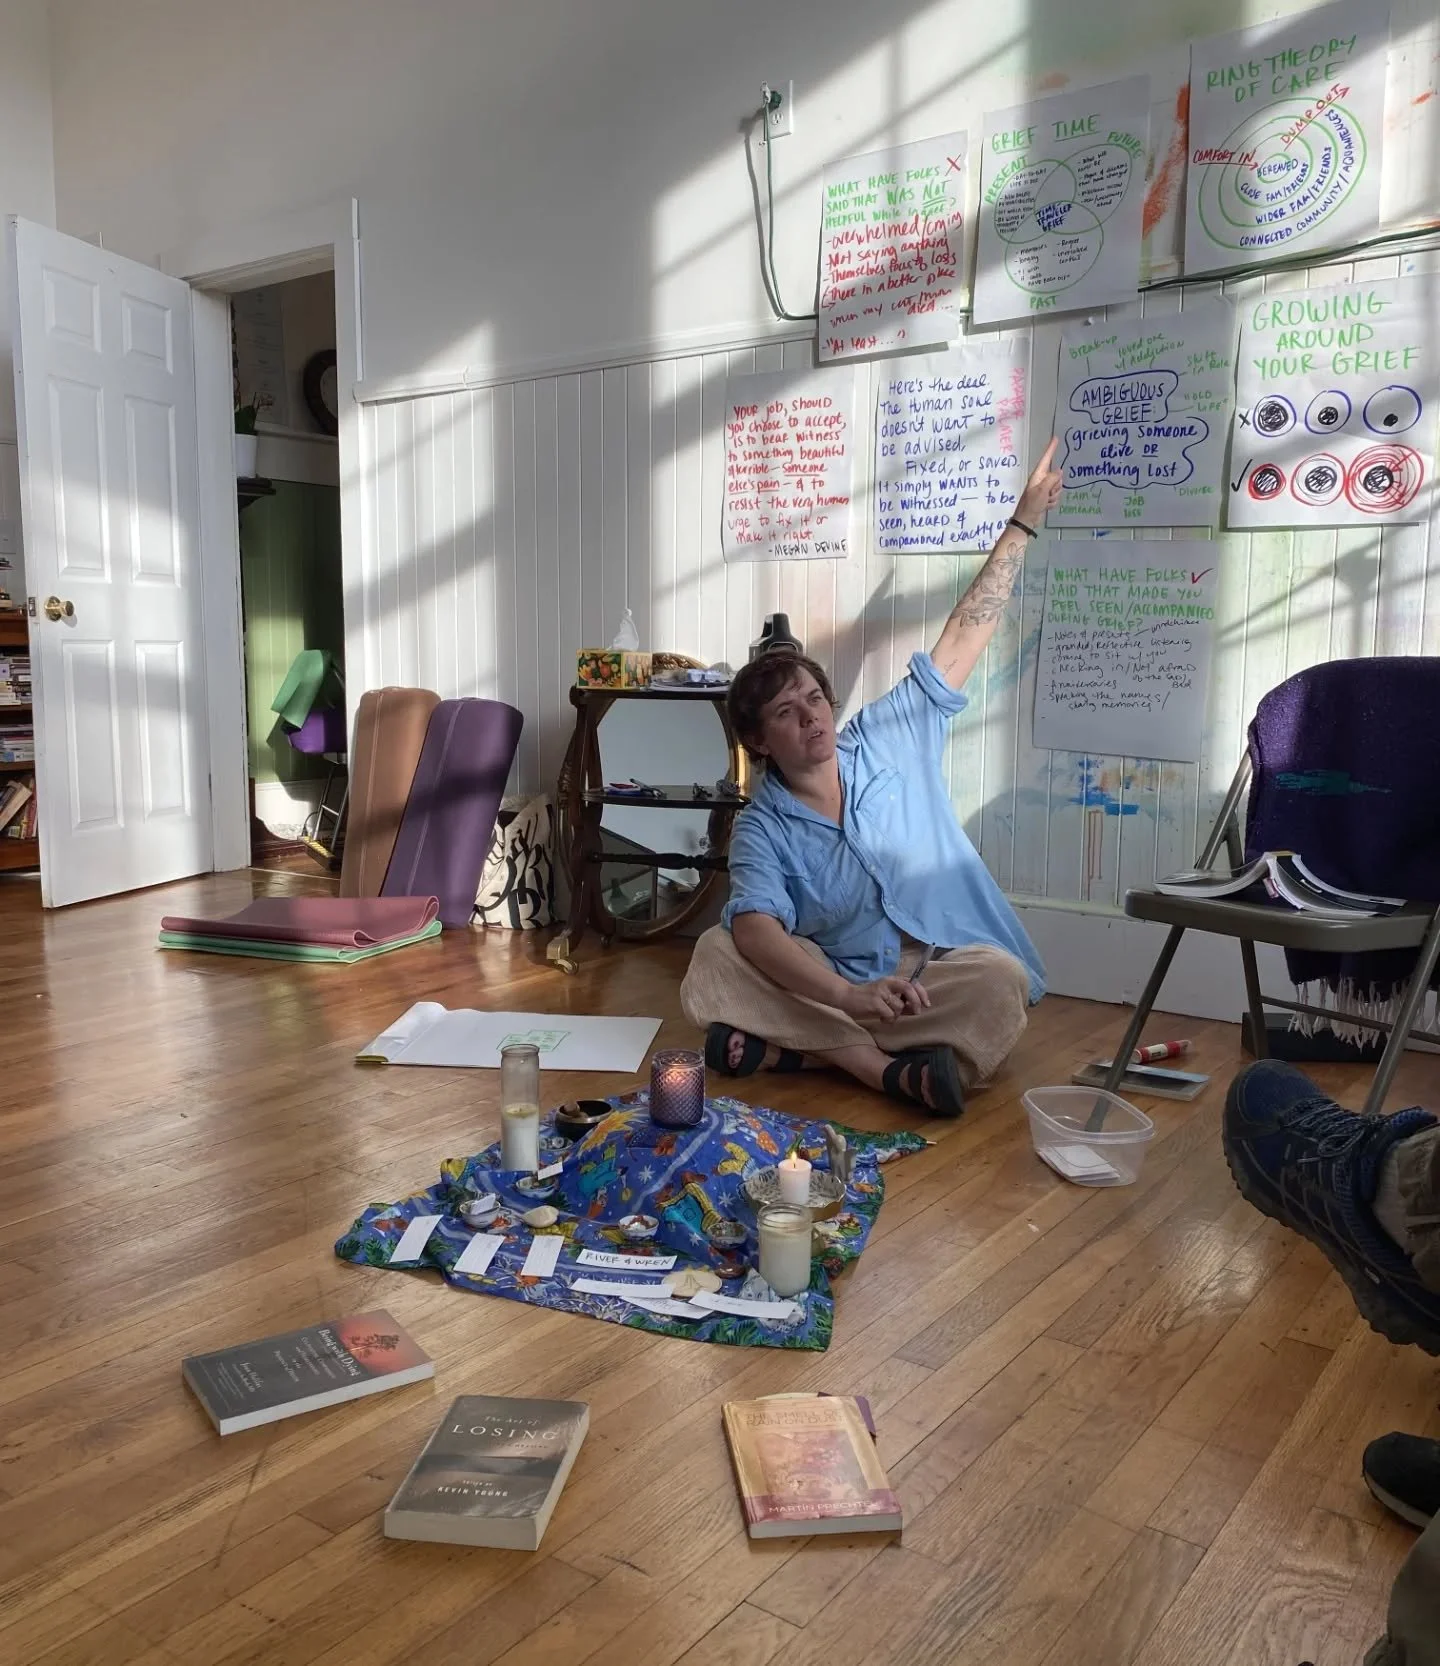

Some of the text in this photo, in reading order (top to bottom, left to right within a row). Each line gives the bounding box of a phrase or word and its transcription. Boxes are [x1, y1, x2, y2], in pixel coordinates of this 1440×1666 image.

[1207, 35, 1356, 92] RING THEORY
[1235, 61, 1345, 102] OF CARE
[1281, 84, 1341, 144] DUMP OUT
[991, 115, 1100, 151] GRIEF TIME
[1108, 131, 1146, 159] FUTURE
[1193, 149, 1256, 163] COMFORT IN
[1257, 159, 1298, 177] BEREAVED
[828, 167, 940, 200] WHAT HAVE FOLKS
[984, 156, 1029, 204] PRESENT
[1241, 183, 1260, 199] CLOSE
[826, 201, 849, 213] SAID
[853, 195, 877, 208] THAT
[887, 190, 914, 204] WAS
[826, 213, 864, 229] HELPFUL
[1256, 207, 1286, 224] WIDER
[1240, 228, 1292, 246] CONNECTED
[858, 246, 897, 262] saying
[1030, 296, 1057, 309] PAST
[1253, 291, 1392, 331] GROWING
[1277, 323, 1374, 352] AROUND
[1253, 346, 1422, 380] YOUR GRIEF
[889, 378, 923, 395] Here's
[929, 378, 953, 392] the
[1082, 382, 1164, 407] AMBIGUOUS
[880, 402, 901, 415] The
[961, 391, 993, 409] soul
[728, 421, 744, 439] you
[749, 420, 783, 433] choose
[788, 416, 798, 427] to
[882, 416, 924, 438] doesn't
[981, 413, 995, 429] to
[734, 436, 743, 448] is
[747, 435, 756, 444] to
[1073, 427, 1129, 451] grieving
[728, 444, 844, 463] to something beautiful
[882, 443, 895, 456] be
[1101, 444, 1159, 459] alive OR
[959, 459, 972, 471] or
[1069, 461, 1139, 485] something
[729, 481, 754, 492] else's
[758, 481, 780, 493] pain
[811, 479, 824, 490] to
[879, 474, 1000, 499] It simply WANTS to
[729, 493, 849, 516] resist the very human
[880, 497, 893, 512] be
[986, 491, 996, 503] to
[1000, 493, 1015, 504] be
[728, 512, 828, 532] urge to fix it or
[957, 511, 966, 529] &
[736, 531, 762, 544] make
[769, 531, 776, 540] it
[950, 522, 993, 542] exactly
[815, 539, 847, 552] DEVINE
[978, 540, 990, 551] it
[1054, 567, 1187, 582] WHAT HAVE FOLKS
[1051, 584, 1203, 600] SAID THAT MADE YOU
[1052, 600, 1081, 612] FEEL
[1048, 612, 1090, 625] DURING
[635, 1257, 672, 1266] WREN
[452, 1424, 558, 1440] LOSING
[769, 1504, 814, 1512] MARTIN
